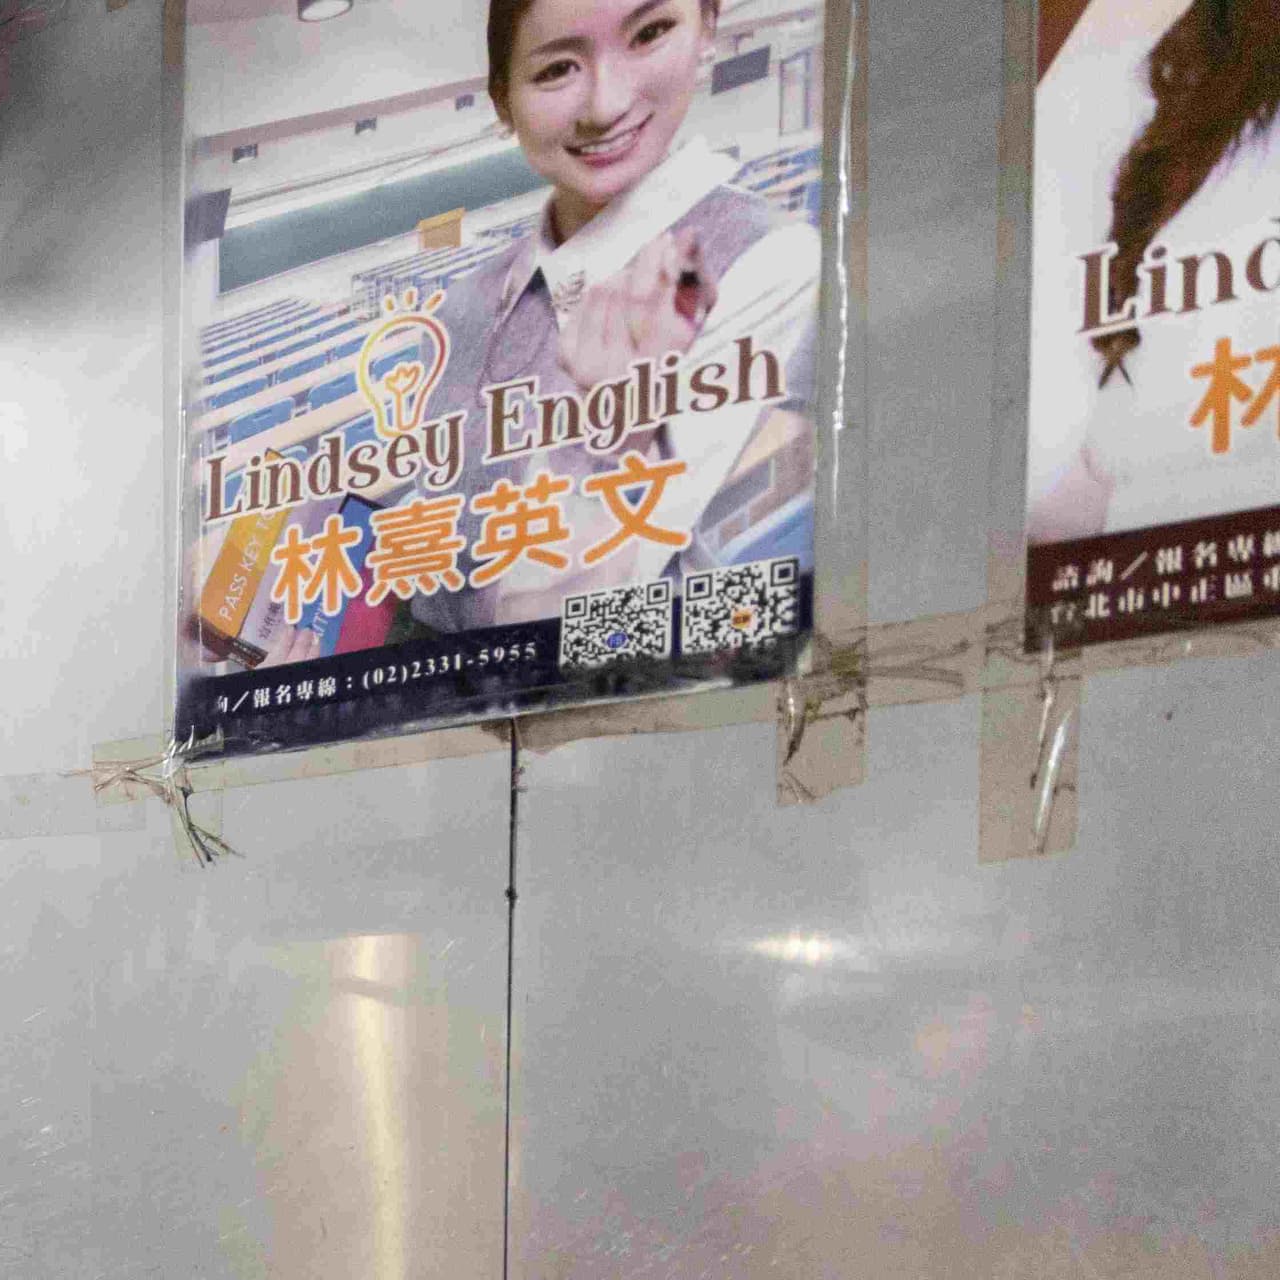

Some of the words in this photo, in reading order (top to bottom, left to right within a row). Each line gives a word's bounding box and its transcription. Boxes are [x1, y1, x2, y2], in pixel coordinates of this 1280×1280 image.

[204, 410, 465, 523] Lindsey
[486, 335, 786, 461] English
[271, 455, 691, 622] 林熹英文
